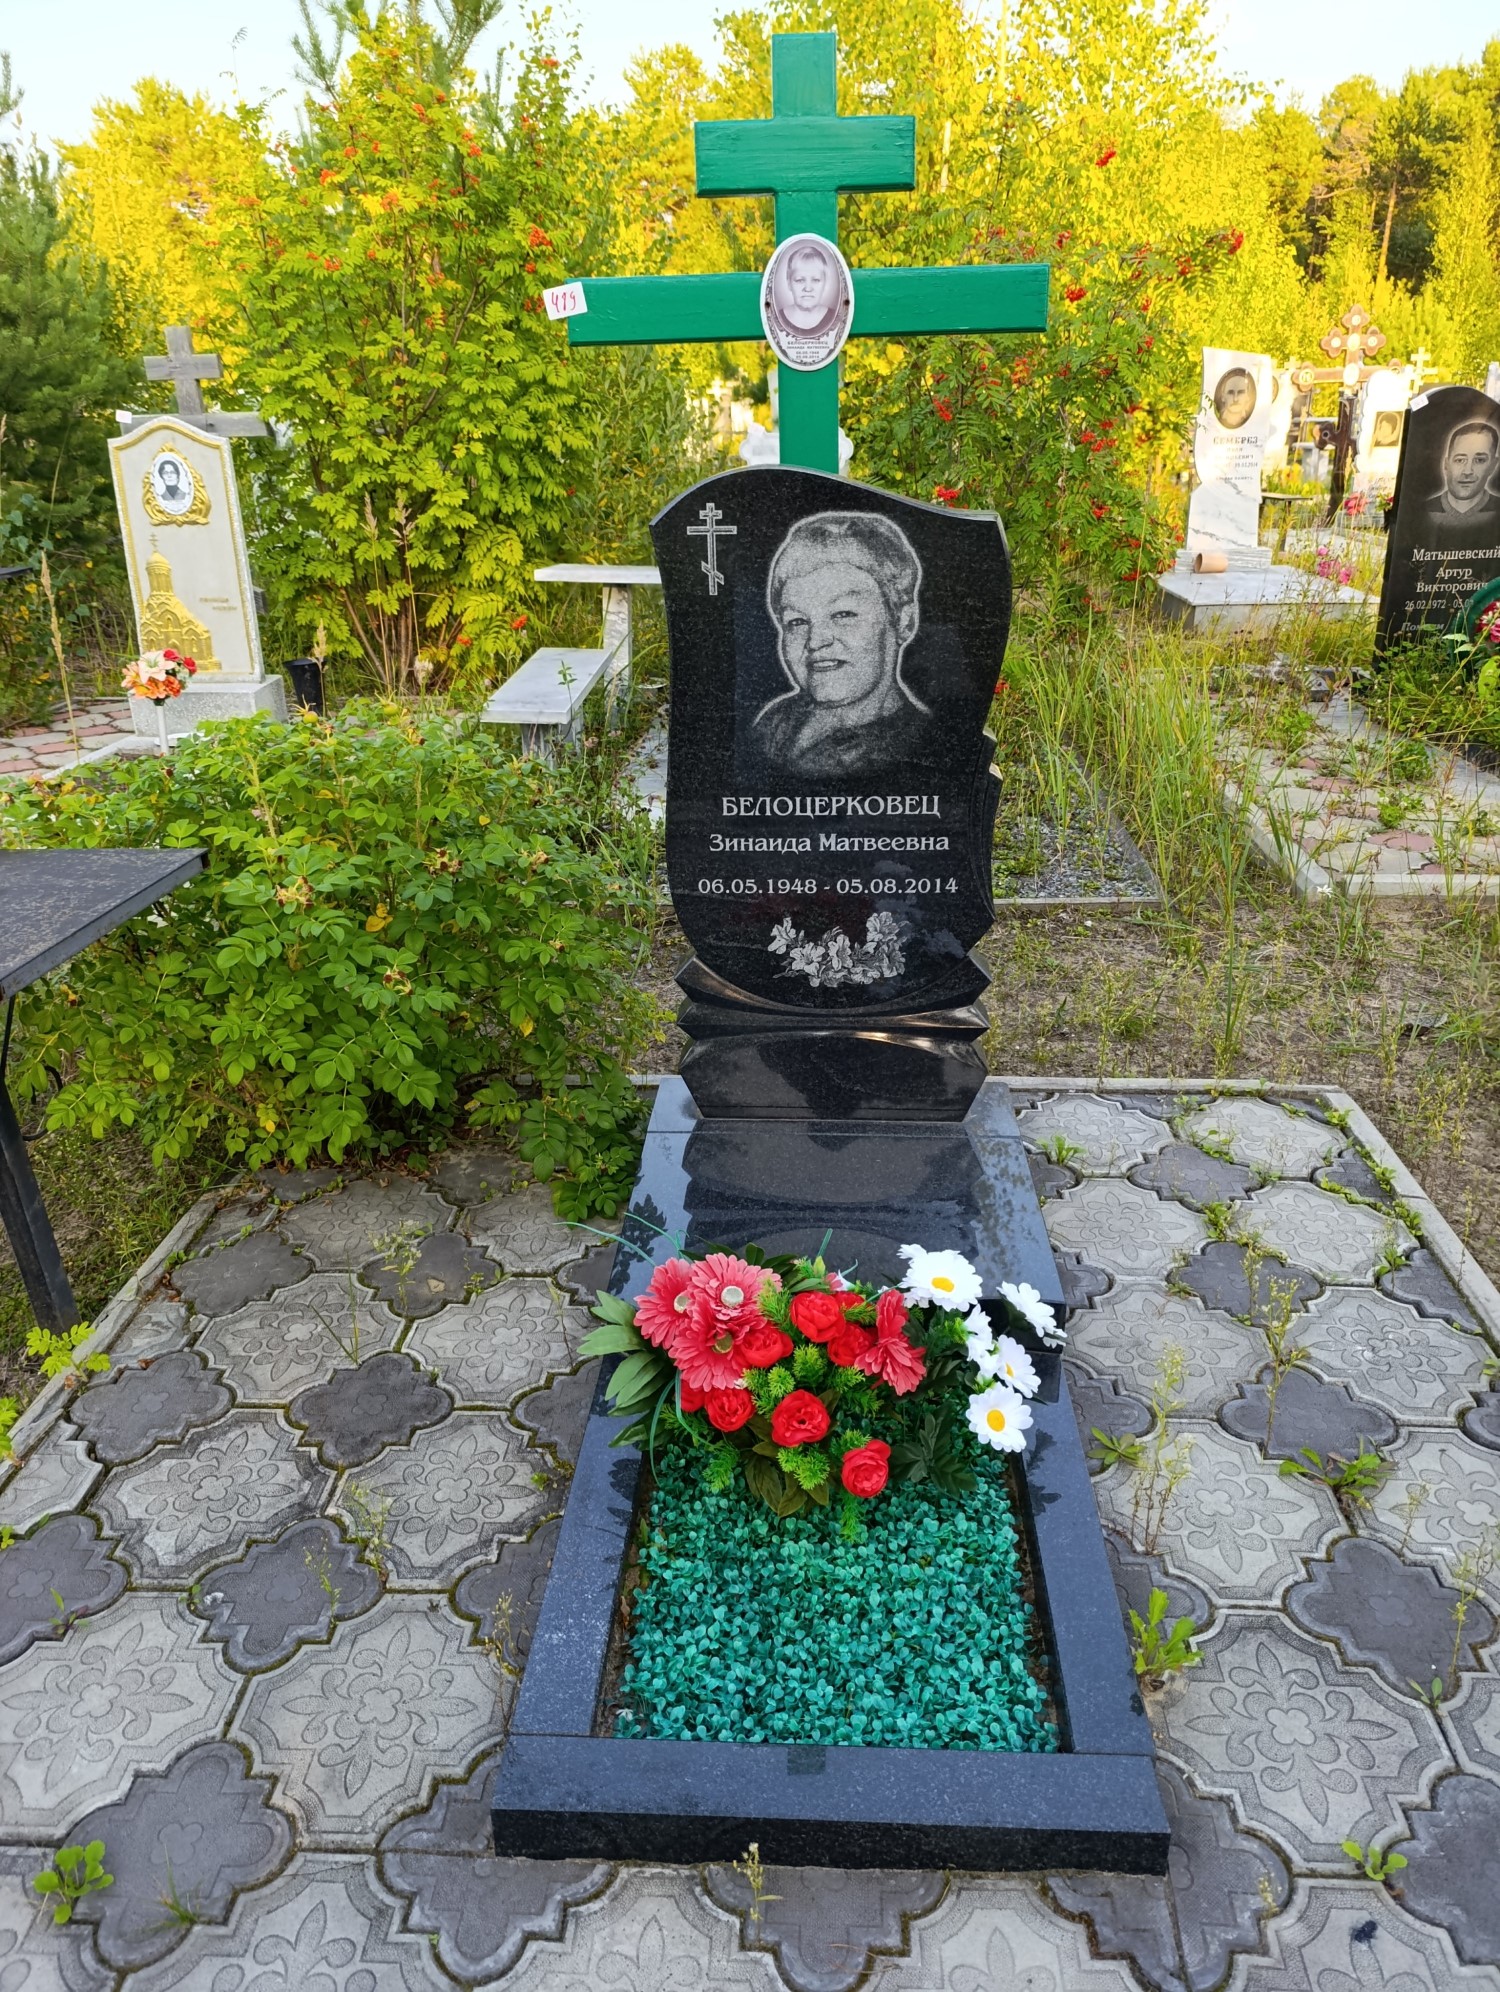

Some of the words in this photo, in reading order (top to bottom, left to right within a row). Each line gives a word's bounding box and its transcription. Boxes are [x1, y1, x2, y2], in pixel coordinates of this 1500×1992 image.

[1436, 567, 1472, 579] Артур
[721, 795, 941, 819] БЕЛОЦЕРКОВЕЦ
[709, 833, 811, 854] Зинаида
[819, 833, 949, 851] Матвеевна
[698, 878, 817, 894] 06.05.1948
[836, 877, 959, 894] 05.08.2014
